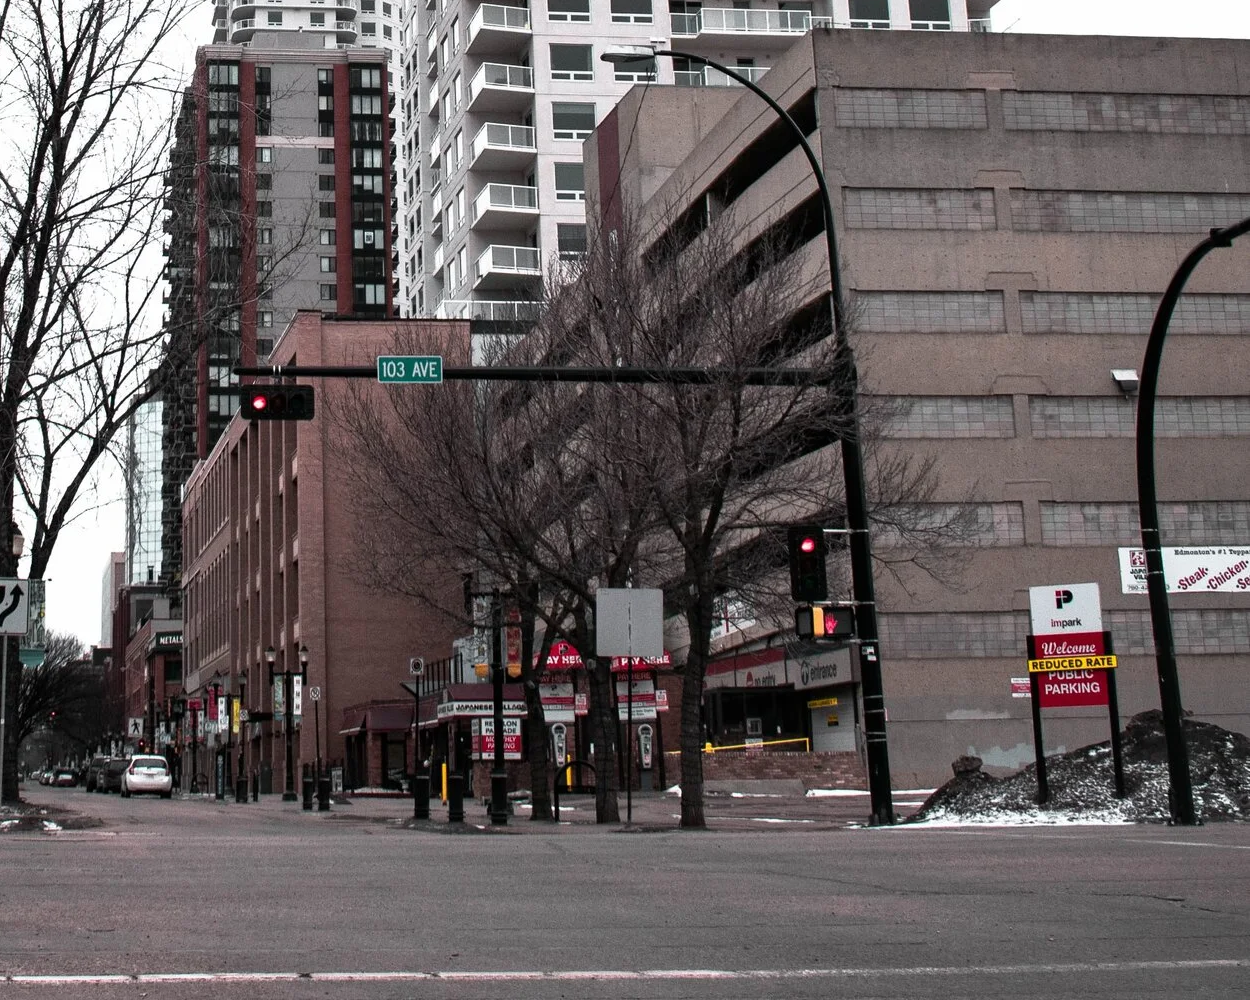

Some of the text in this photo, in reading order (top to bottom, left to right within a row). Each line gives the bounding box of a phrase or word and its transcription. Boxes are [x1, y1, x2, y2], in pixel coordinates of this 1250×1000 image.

[382, 360, 438, 378] 103 AVE
[1050, 618, 1082, 629] impark
[1042, 641, 1097, 655] Welcome
[1032, 657, 1113, 671] REDUCED RATE
[1044, 682, 1101, 695] PARKING
[456, 703, 493, 711] JAPANESE
